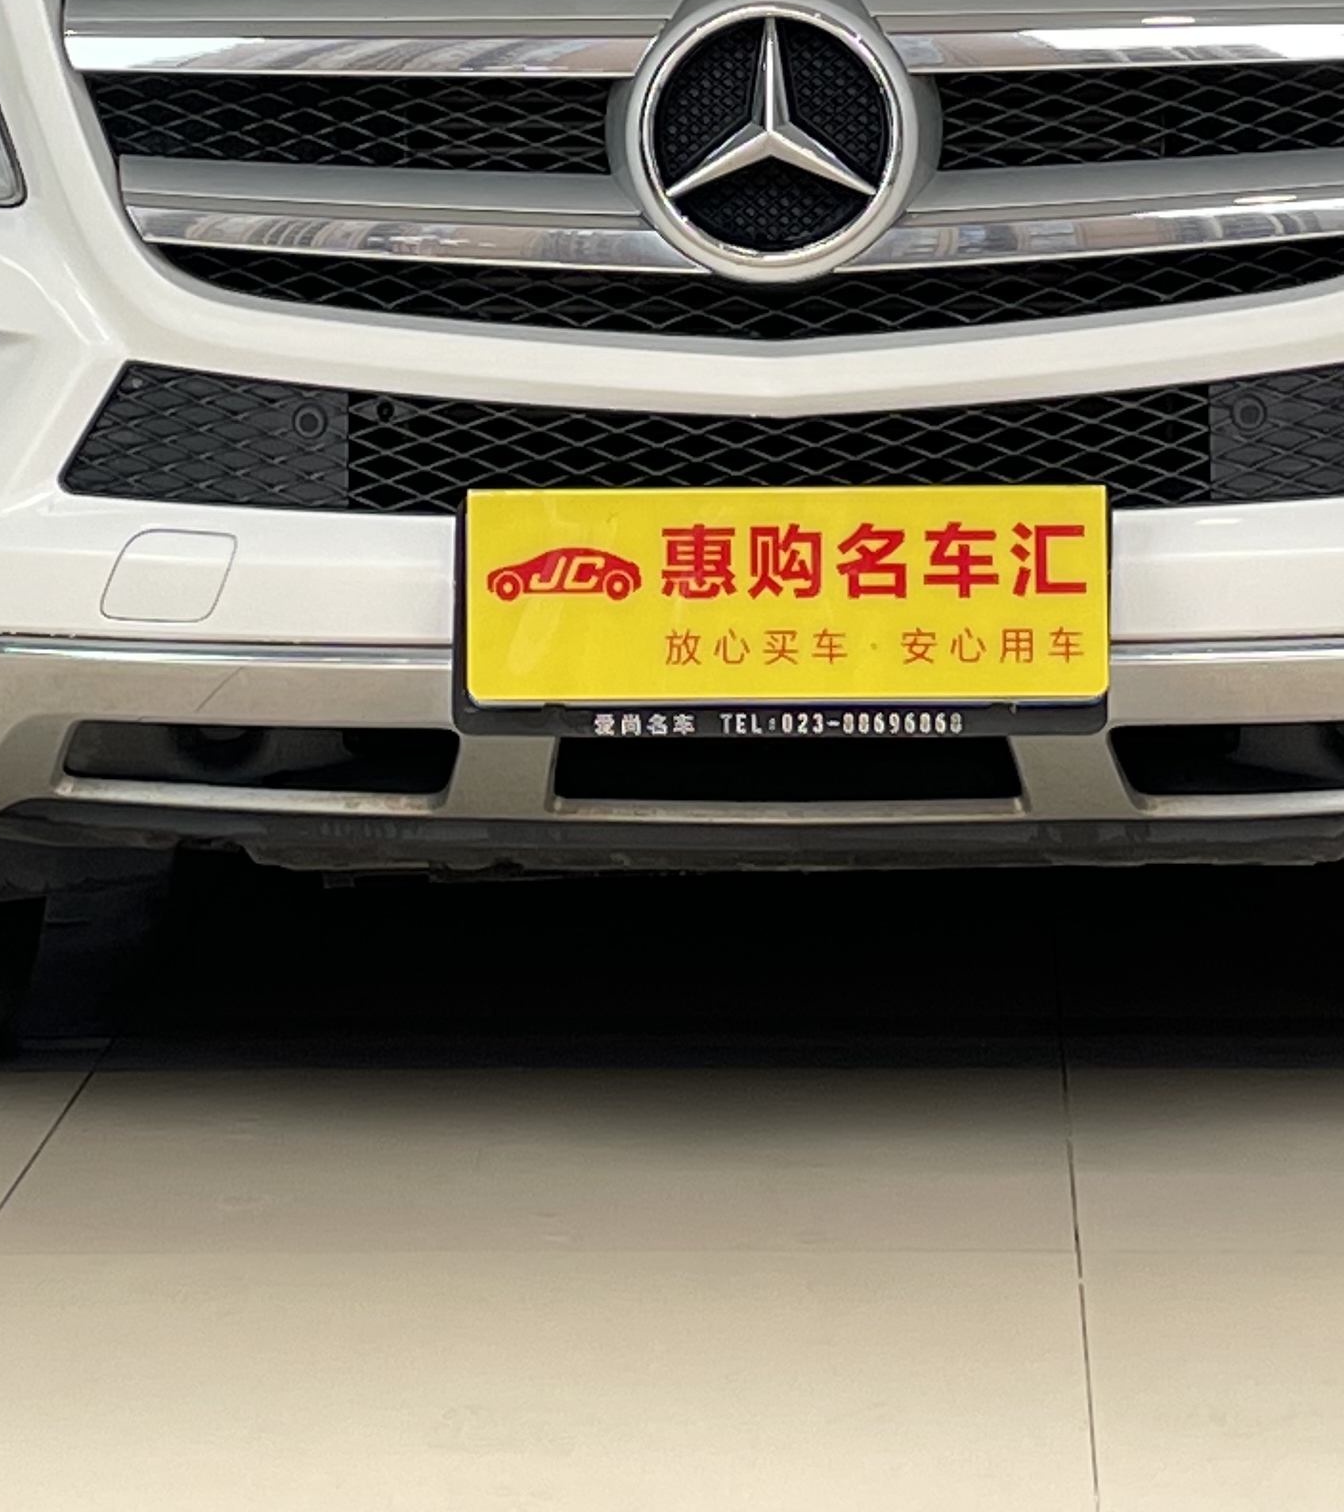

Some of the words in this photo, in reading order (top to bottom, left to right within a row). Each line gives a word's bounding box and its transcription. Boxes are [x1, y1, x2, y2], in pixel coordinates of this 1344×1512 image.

[661, 521, 1087, 599] 惠购名车汇
